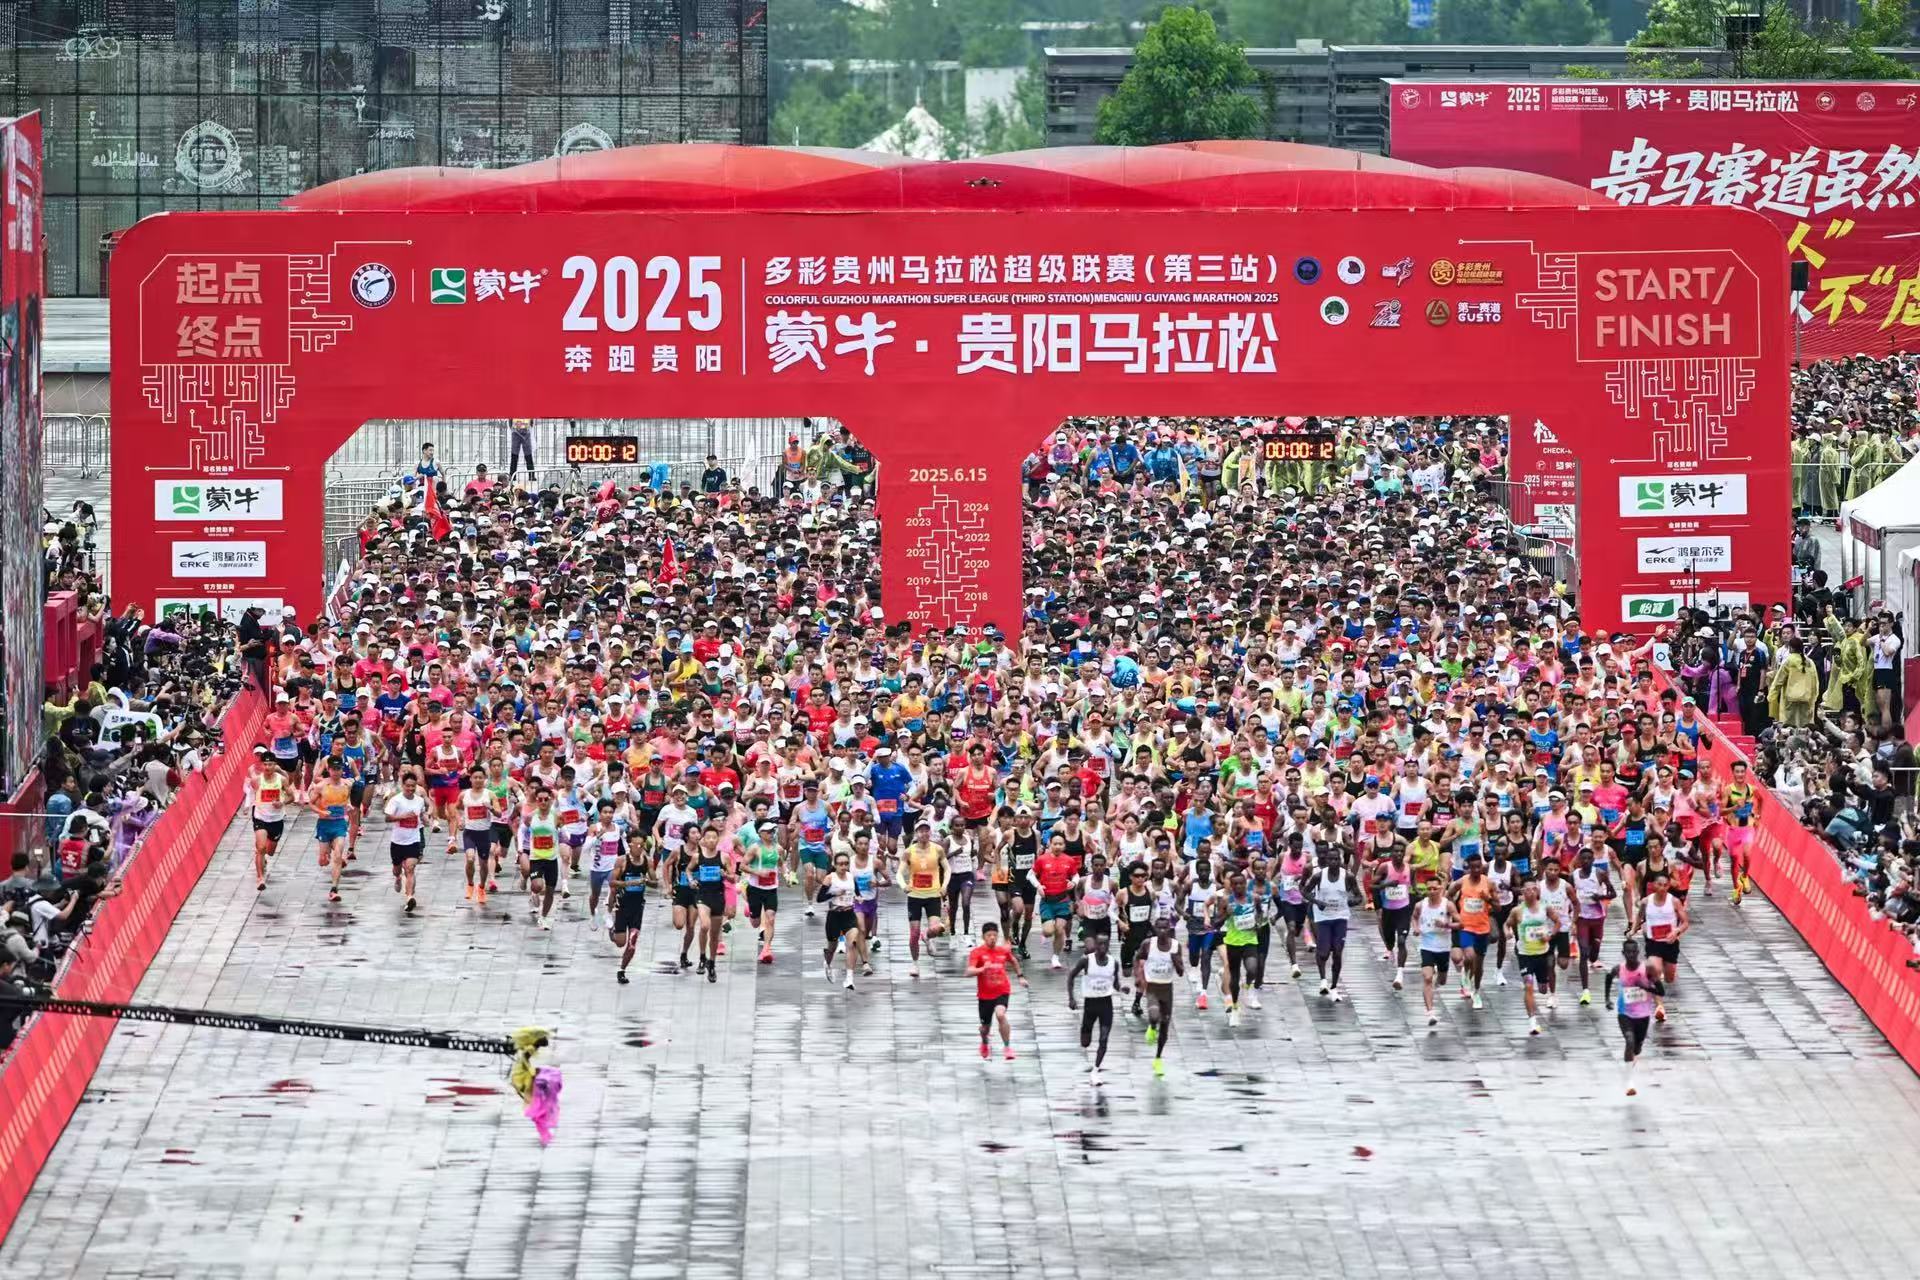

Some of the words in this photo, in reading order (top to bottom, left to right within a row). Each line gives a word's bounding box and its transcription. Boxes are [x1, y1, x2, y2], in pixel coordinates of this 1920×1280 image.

[1507, 87, 1541, 103] 2025
[1625, 88, 1799, 112] 蒙牛·贵阳马拉松
[176, 262, 263, 304] 起点
[474, 268, 541, 304] 蒙牛
[1596, 266, 1734, 306] START/
[562, 256, 723, 332] 2025
[765, 296, 820, 305] COLORFUL
[822, 296, 870, 305] GUIZHOU
[872, 295, 931, 304] MARATHON
[933, 295, 967, 304] SUPER
[969, 295, 1009, 304] LEAGUE
[1011, 294, 1046, 304] (THIRD
[1144, 294, 1190, 303] GUIYANG
[1193, 294, 1252, 303] MARATHON
[1254, 293, 1279, 302] 2025
[1458, 302, 1501, 313] 第一赛道
[1458, 313, 1501, 322] GUSTO
[176, 316, 263, 358] 终点
[1596, 313, 1732, 348] FINISH
[568, 445, 636, 461] 00:00:12
[1266, 442, 1333, 459] 00:00:12
[909, 468, 987, 482] 2025.6.15
[206, 486, 260, 513] 蒙牛
[1670, 483, 1723, 508] 蒙牛
[963, 503, 989, 512] 2024
[906, 518, 932, 526] 2023
[964, 533, 990, 542] 2022
[212, 551, 259, 562] 鸿星尔克
[906, 548, 931, 557] 2021
[1677, 546, 1724, 557] 鸿星尔克
[964, 560, 990, 568] 2020
[906, 577, 931, 585] 2019
[964, 593, 988, 601] 2018
[907, 611, 930, 619] 2017
